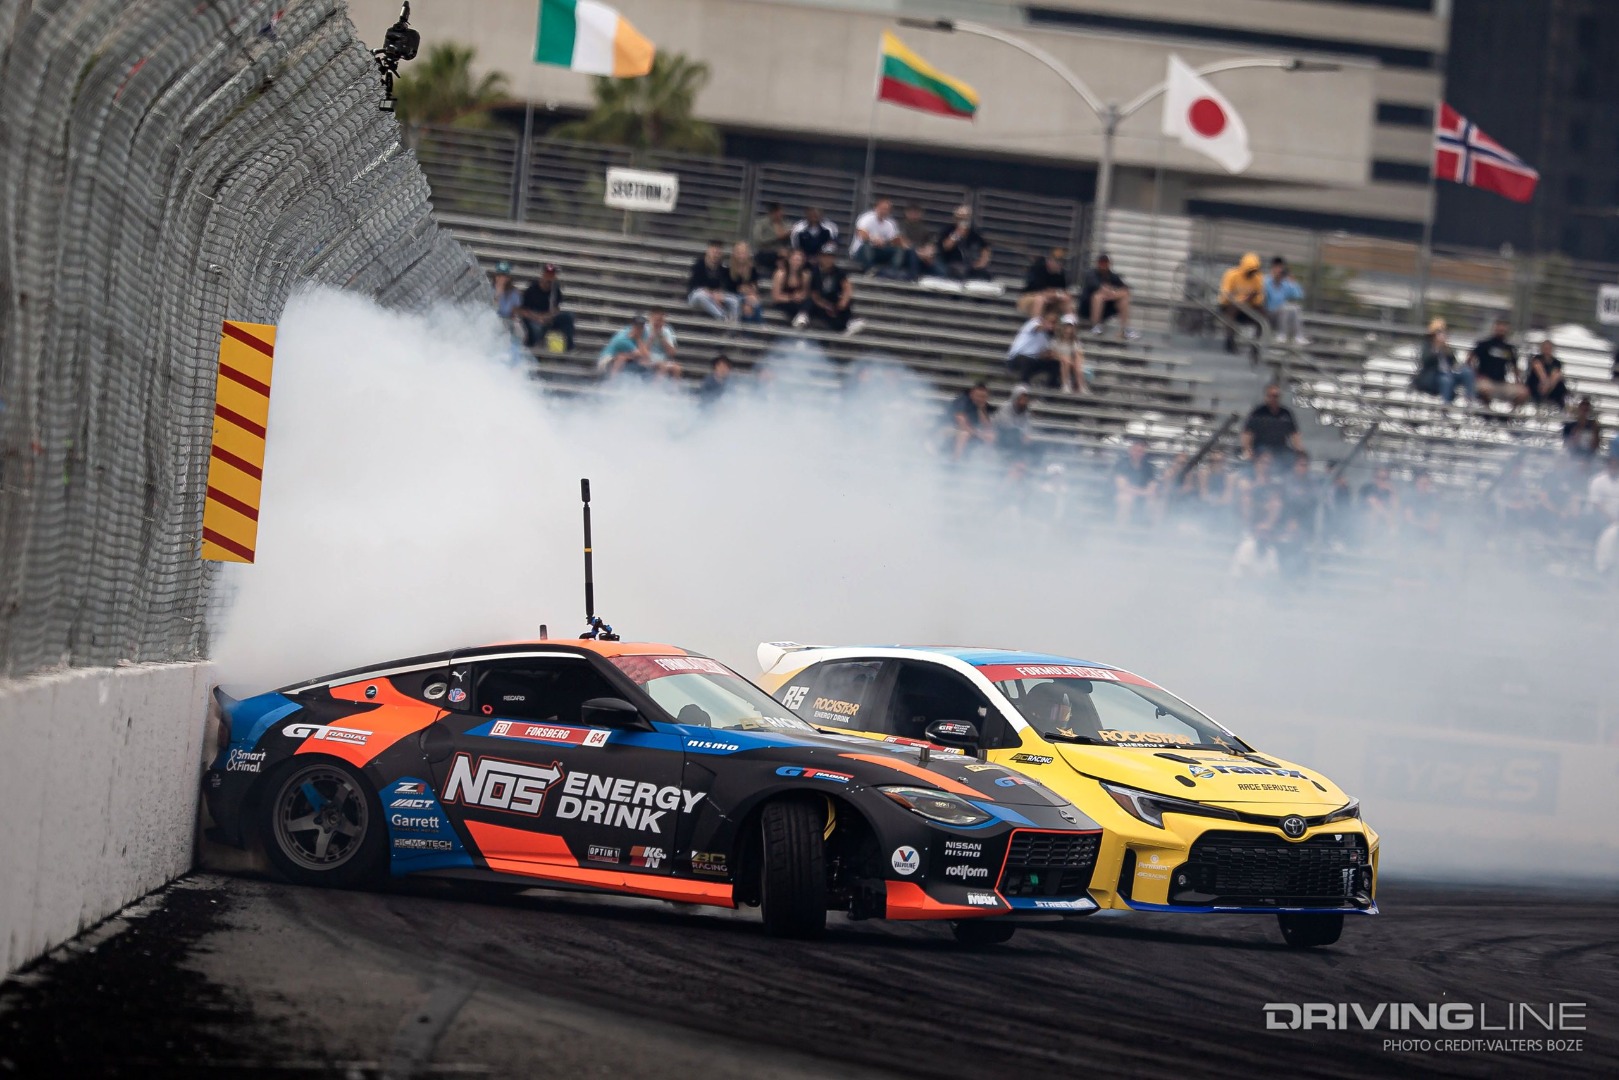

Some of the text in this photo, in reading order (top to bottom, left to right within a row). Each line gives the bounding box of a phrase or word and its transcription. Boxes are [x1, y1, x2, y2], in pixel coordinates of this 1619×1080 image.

[611, 181, 662, 200] SECTION
[1015, 667, 1079, 677] FORMULA
[781, 685, 810, 710] RS
[812, 697, 861, 716] ROCKSTAR
[814, 710, 851, 723] ENERGY DRINK
[328, 731, 368, 742] RADIAL
[525, 726, 571, 740] FORSBERG
[589, 733, 605, 744] 64
[237, 749, 266, 762] Smart
[1027, 755, 1053, 764] RACING
[816, 771, 850, 782] RADIAL
[444, 755, 562, 814] NOS
[1237, 783, 1300, 793] RACE SERVICE
[562, 770, 707, 814] ENERGY
[391, 814, 440, 828] Garrett
[556, 795, 667, 834] DRINK
[945, 841, 982, 851] NISSAN
[692, 862, 728, 872] RACING
[945, 864, 988, 880] rotiform
